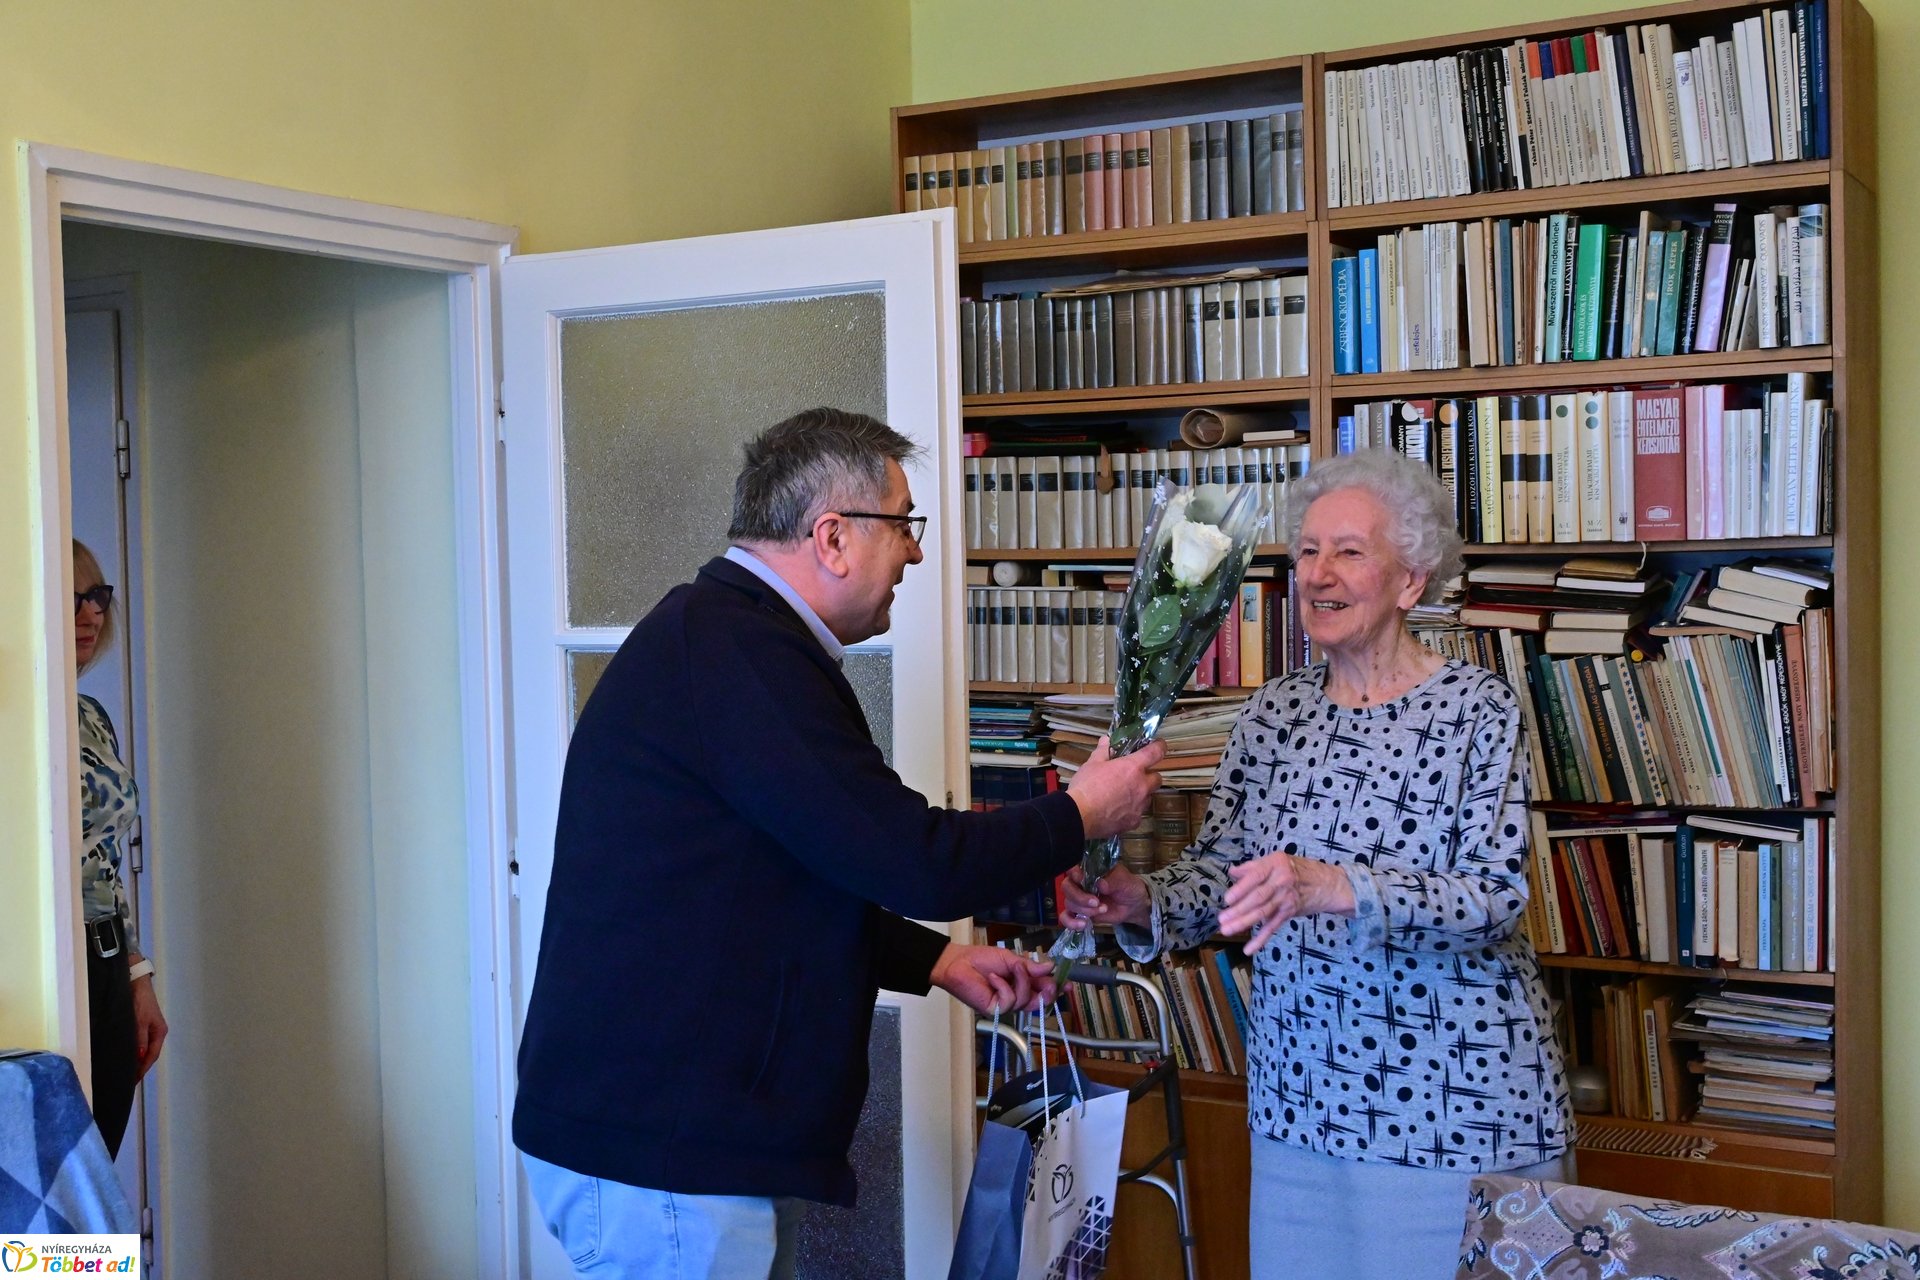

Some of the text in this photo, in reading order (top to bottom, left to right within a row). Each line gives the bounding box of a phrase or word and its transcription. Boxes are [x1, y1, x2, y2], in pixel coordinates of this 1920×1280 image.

[1800, 78, 1808, 107] BESZÉD
[1548, 222, 1560, 326] Művészetről mindenkinek
[1564, 247, 1574, 297] LEONARDO
[1413, 324, 1421, 356] nefelejcs
[1636, 398, 1680, 419] MAGYAR
[1484, 414, 1492, 458] LEXIKON
[1467, 409, 1477, 510] FILOZÓFIAI KISLEXIKON
[1485, 459, 1495, 515] MŰVÉSZETI
[1786, 478, 1797, 522] HOGYAN
[1584, 666, 1595, 693] CSODÁI
[1792, 660, 1801, 702] MESEKÖNYVE
[1592, 695, 1611, 752] GYERMEKVILÁG
[1785, 726, 1790, 734] AZ
